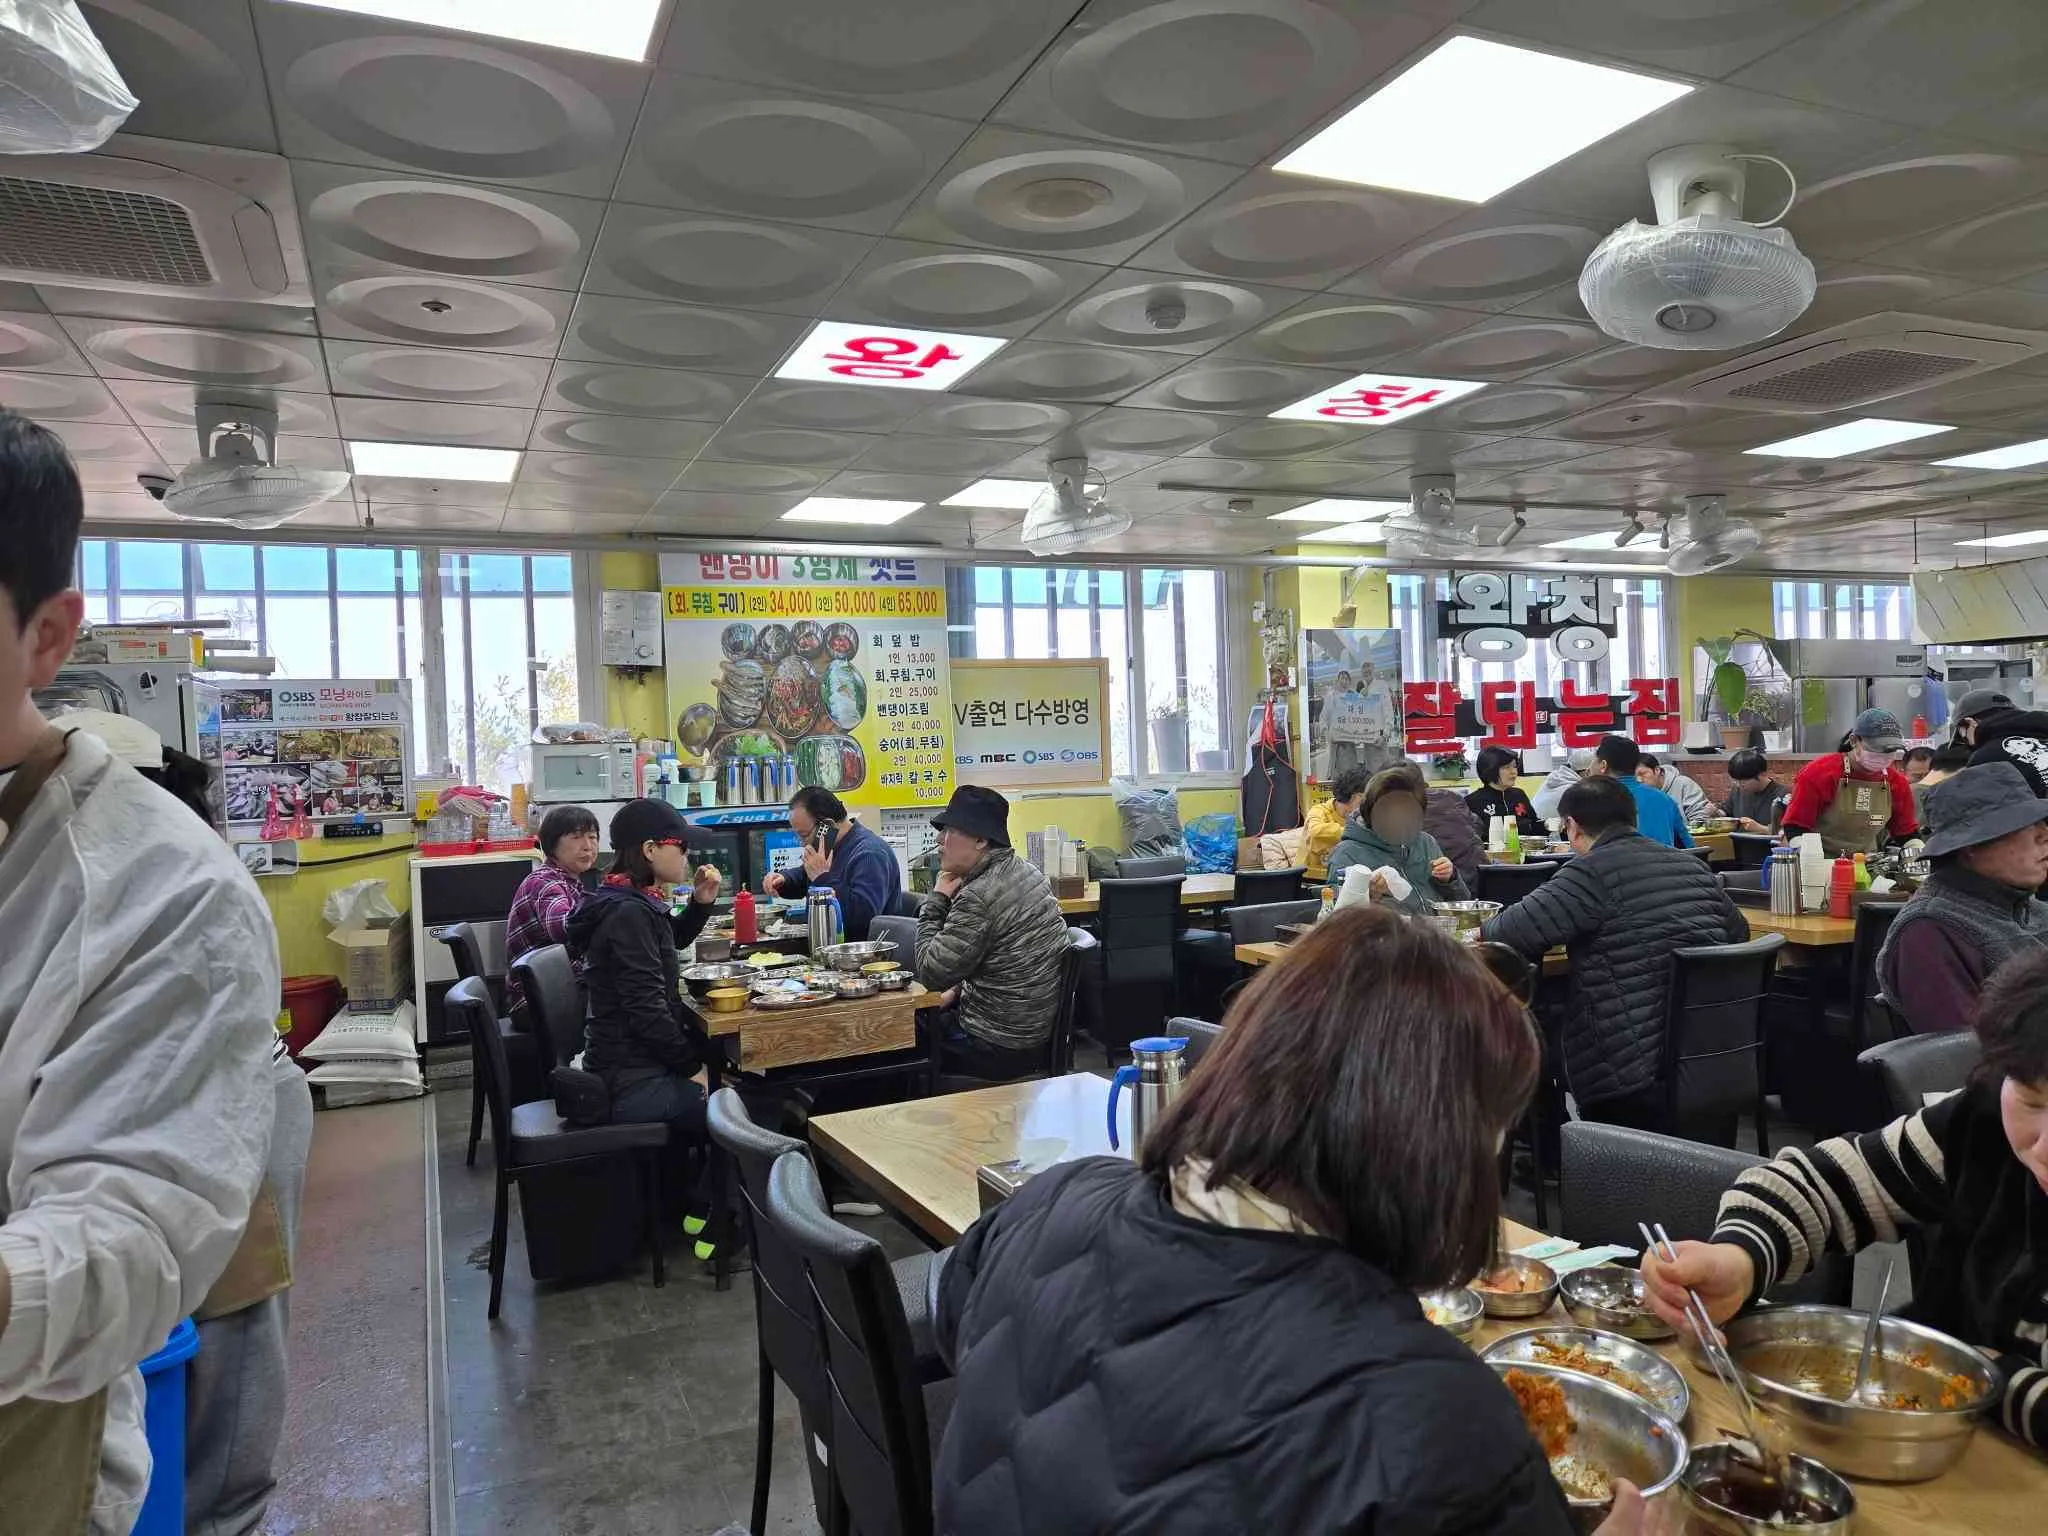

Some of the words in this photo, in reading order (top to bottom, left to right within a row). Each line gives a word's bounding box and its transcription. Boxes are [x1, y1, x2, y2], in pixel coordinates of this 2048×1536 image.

[823, 336, 961, 379] 왕
[769, 590, 812, 616] 34,000
[834, 590, 876, 616] 50,000
[897, 590, 938, 616] 65,000
[1453, 572, 1624, 662] 왕창
[907, 652, 935, 664] 13,000
[909, 686, 938, 698] 25,000
[1015, 698, 1090, 727] 다수방영
[1403, 677, 1681, 753] 잘되는집
[911, 719, 941, 732] 40,000
[1038, 751, 1056, 761] SBS
[1076, 750, 1099, 760] OBS
[915, 786, 943, 799] 10,000
